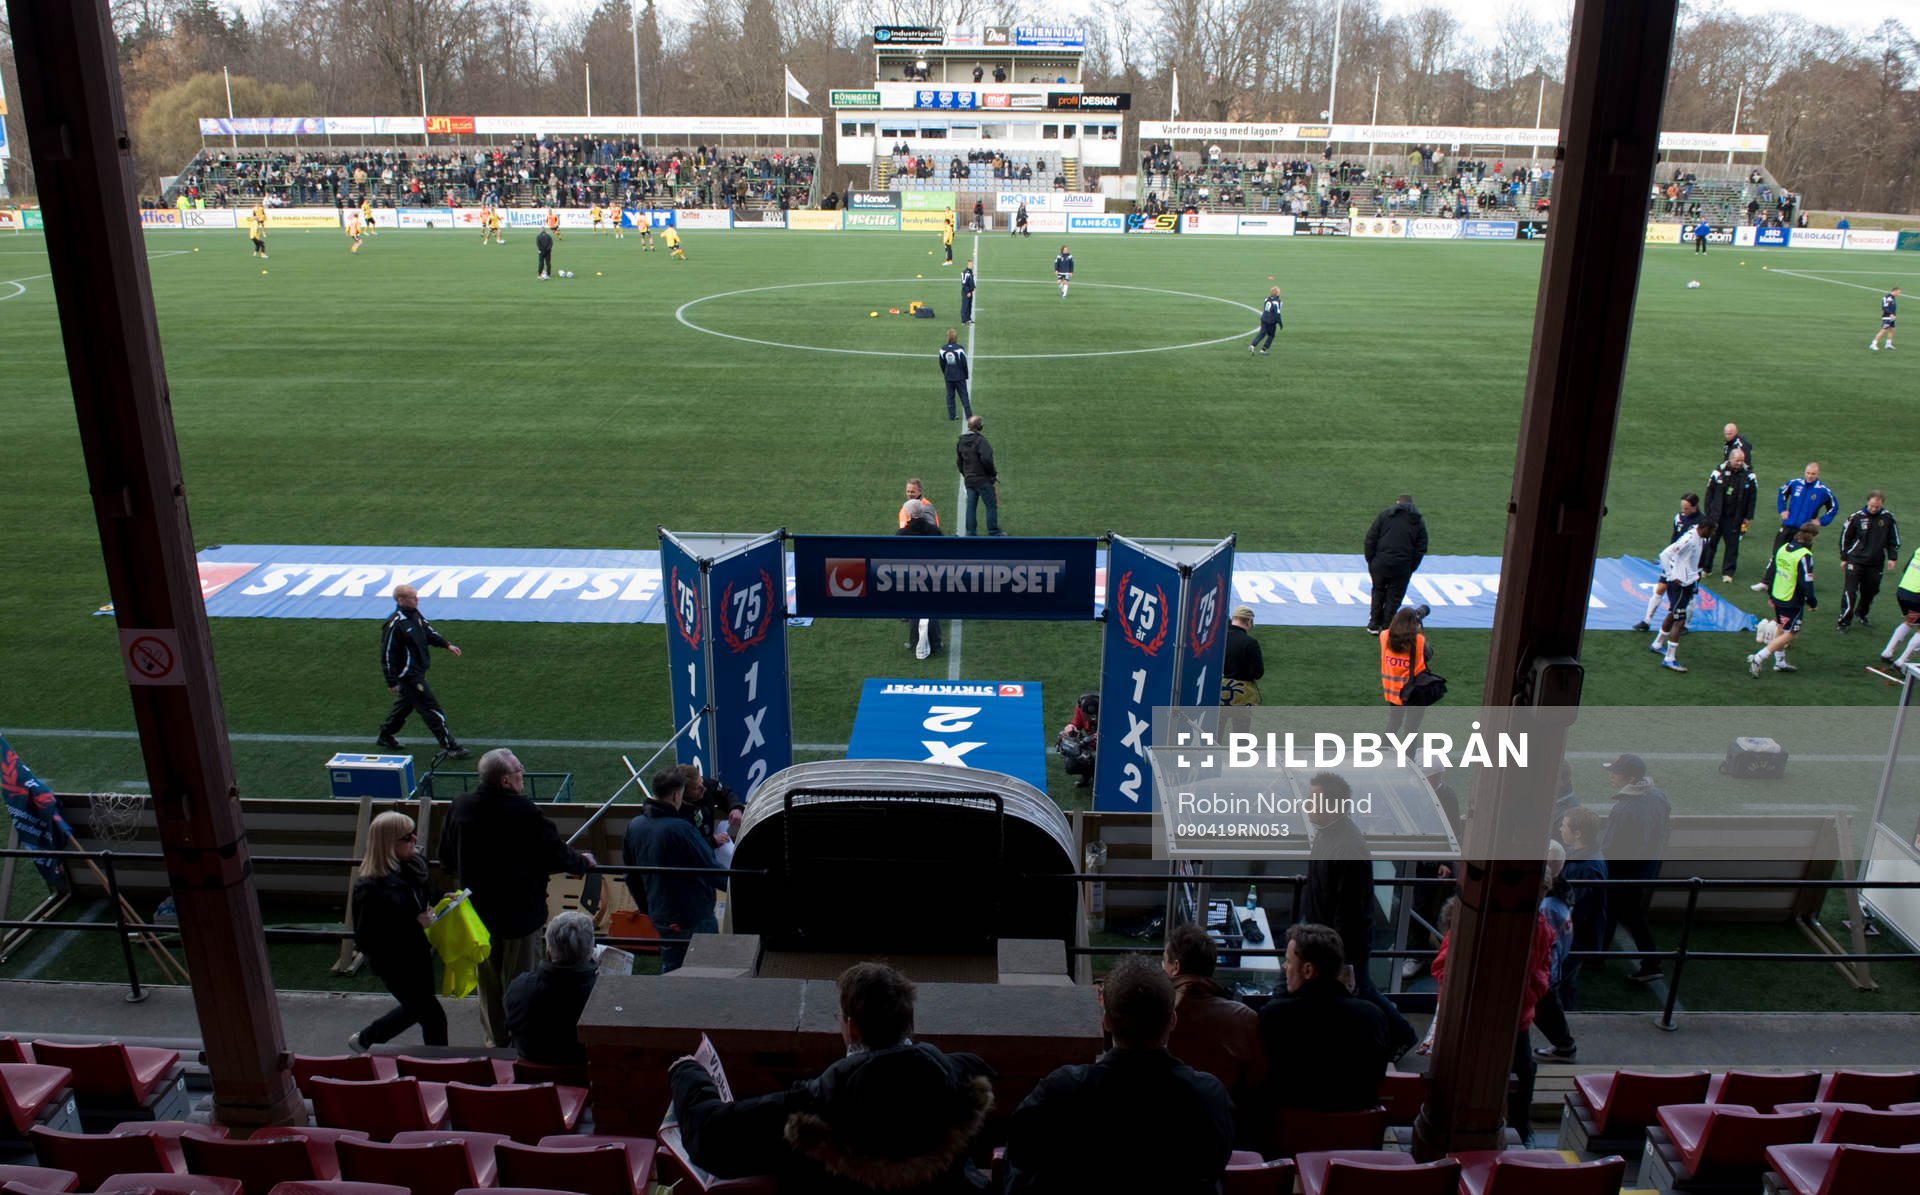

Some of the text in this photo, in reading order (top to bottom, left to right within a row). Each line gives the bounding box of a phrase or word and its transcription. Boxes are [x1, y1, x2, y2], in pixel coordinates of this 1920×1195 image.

[1018, 27, 1084, 37] TRIENNIUM
[1214, 126, 1227, 137] sig
[1229, 126, 1248, 136] med
[1250, 126, 1284, 138] lagom?
[1001, 193, 1046, 205] PROLINE
[240, 566, 663, 602] STRYKTIPSE
[876, 564, 1061, 593] STRYKTIPSET
[677, 578, 695, 624] 75
[733, 581, 764, 631] 75
[1127, 584, 1158, 631] 75
[1196, 585, 1218, 635] 75
[744, 624, 755, 640] år
[1135, 626, 1147, 642] år
[687, 661, 697, 698] 1
[744, 660, 760, 702] 1
[1385, 656, 1411, 669] FOTO
[882, 684, 995, 697] STRYKTIPSET
[1131, 668, 1148, 705] 1
[1195, 664, 1207, 706] 1
[739, 705, 768, 758] X
[922, 705, 982, 733] 2
[1120, 710, 1151, 758] X
[1118, 762, 1143, 804] 2
